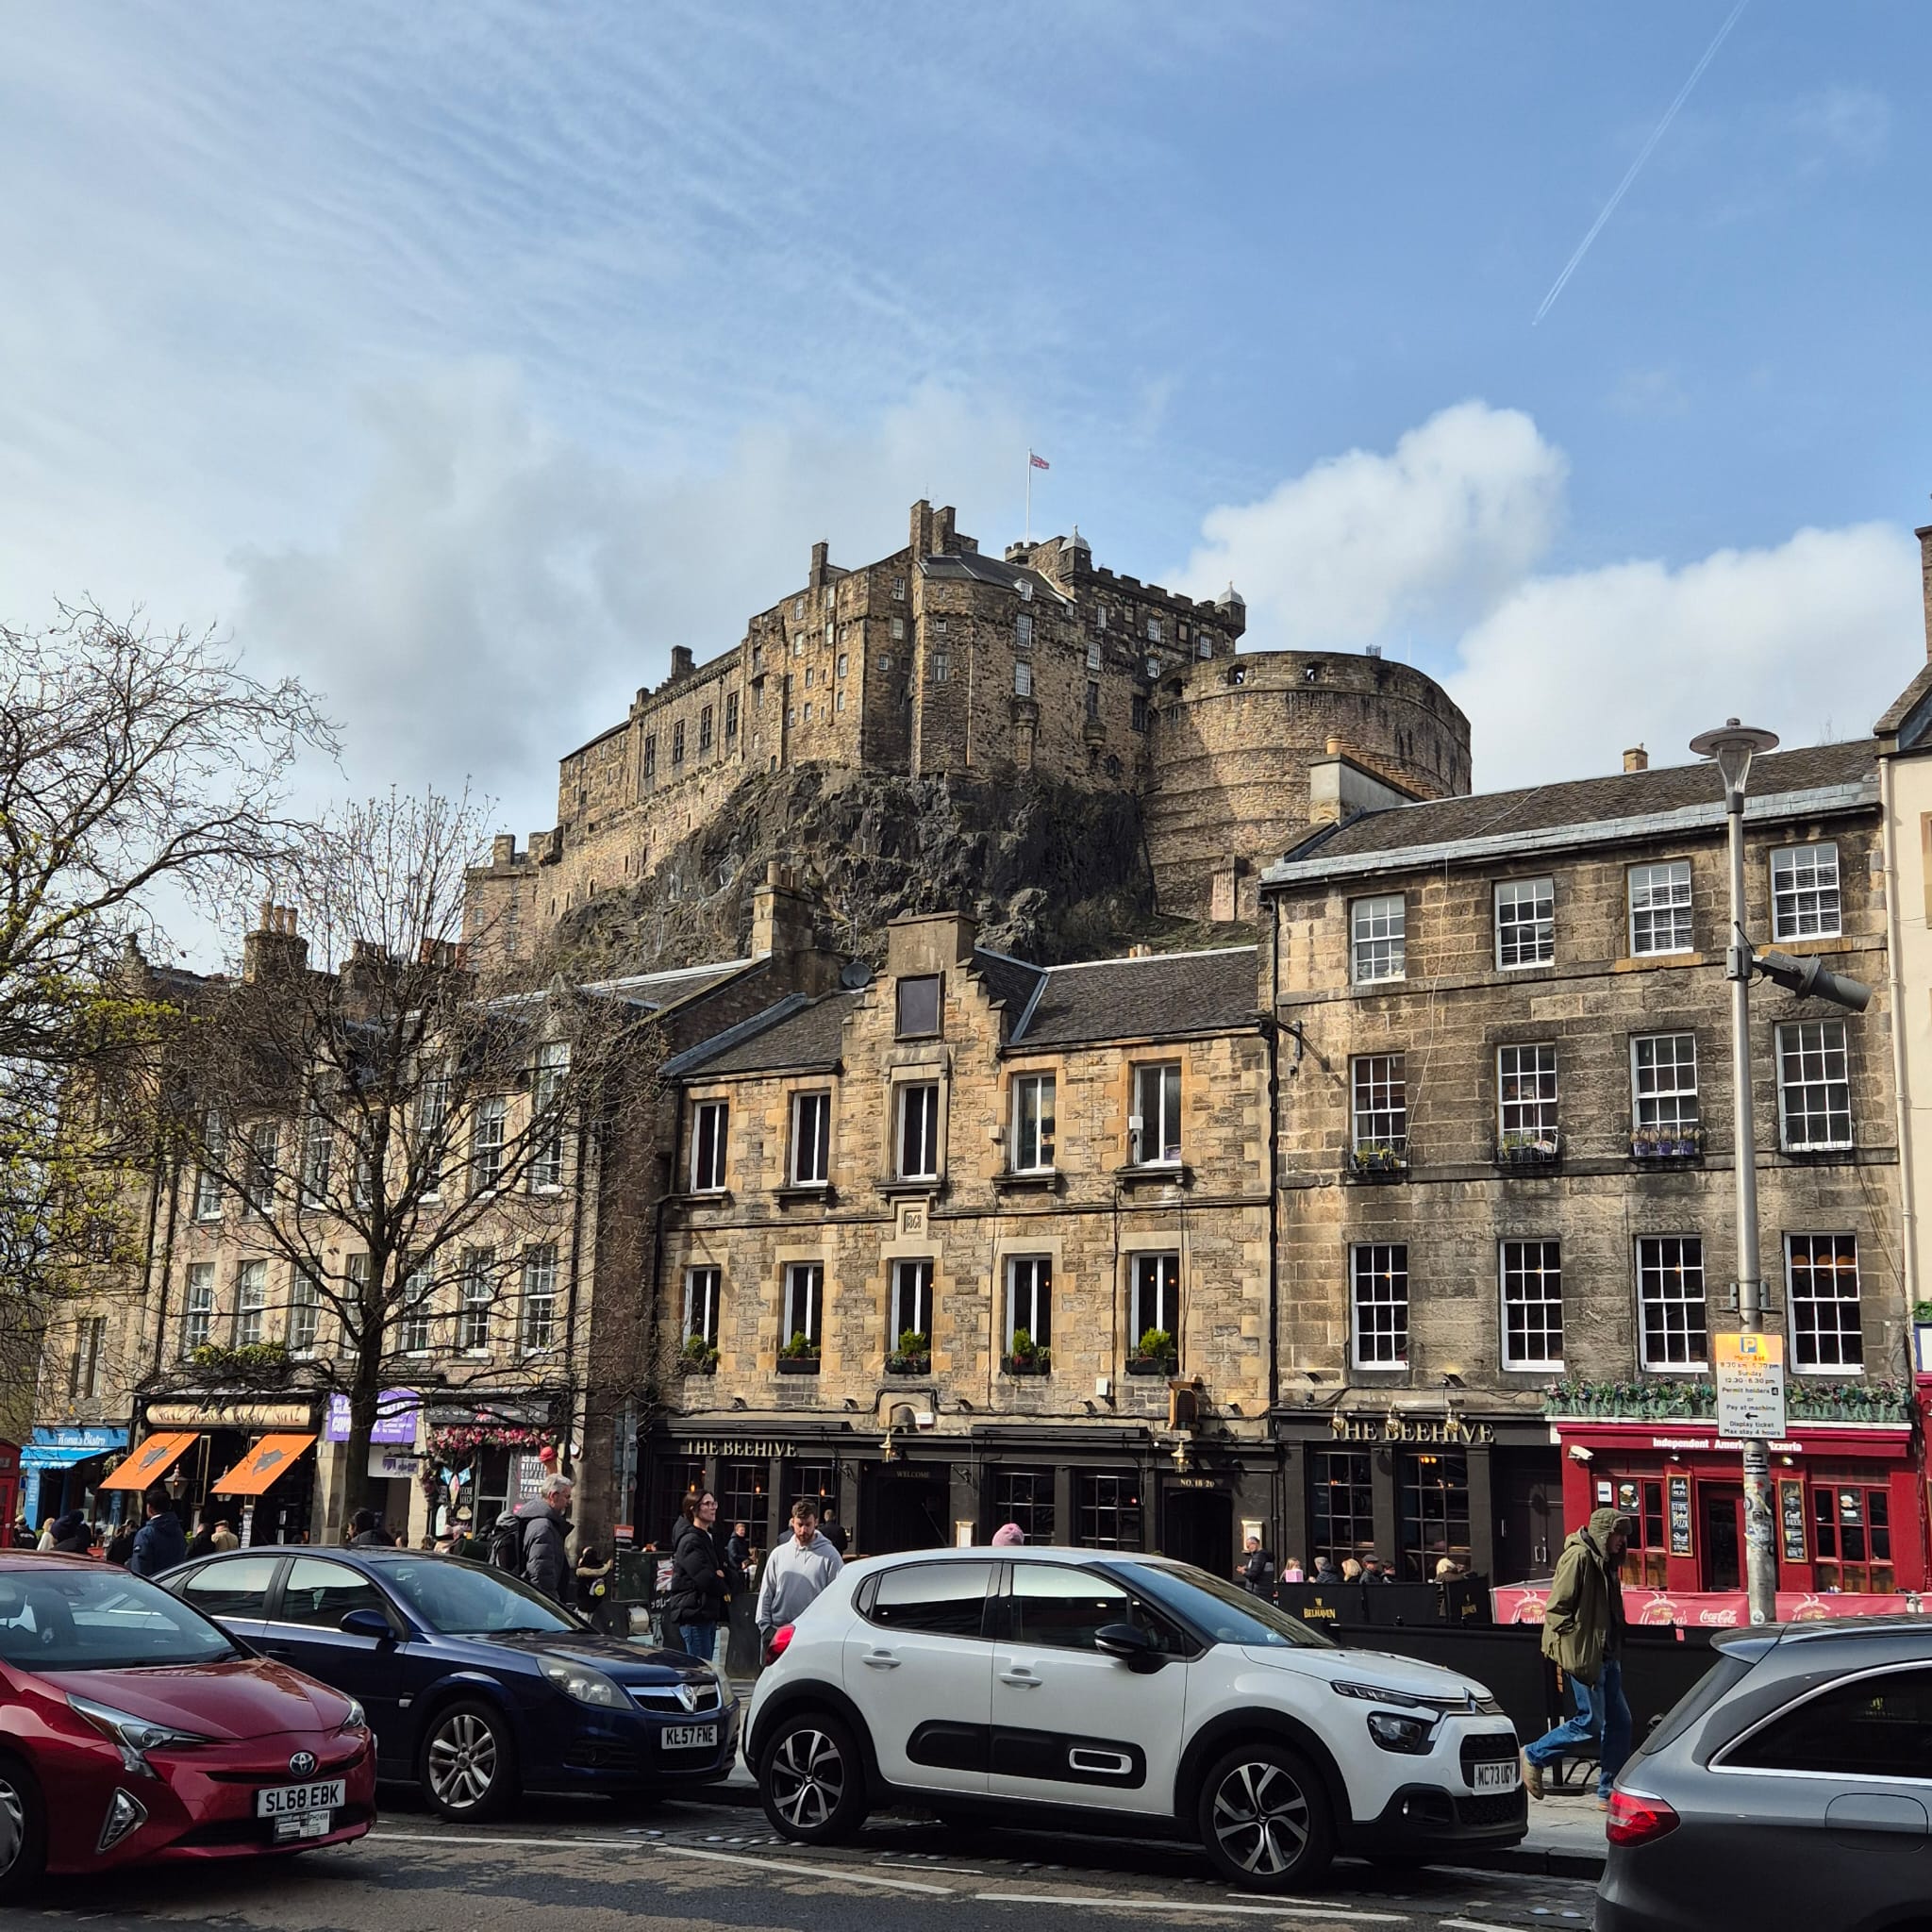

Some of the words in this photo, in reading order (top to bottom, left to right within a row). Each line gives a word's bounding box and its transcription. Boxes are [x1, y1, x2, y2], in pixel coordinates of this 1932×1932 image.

[83, 1431, 106, 1446] Bistro
[1328, 1420, 1377, 1441] THE
[1385, 1422, 1494, 1443] BEEHIVE
[686, 1440, 719, 1456] THE
[723, 1440, 798, 1457] BEEHIVE
[1653, 1437, 1709, 1449] Independent
[1714, 1439, 1744, 1450] Ameri
[666, 1727, 694, 1745] KL57
[696, 1726, 714, 1743] FNE
[1478, 1765, 1500, 1786] MC73
[265, 1788, 307, 1812] SL68
[310, 1784, 340, 1807] EBK
